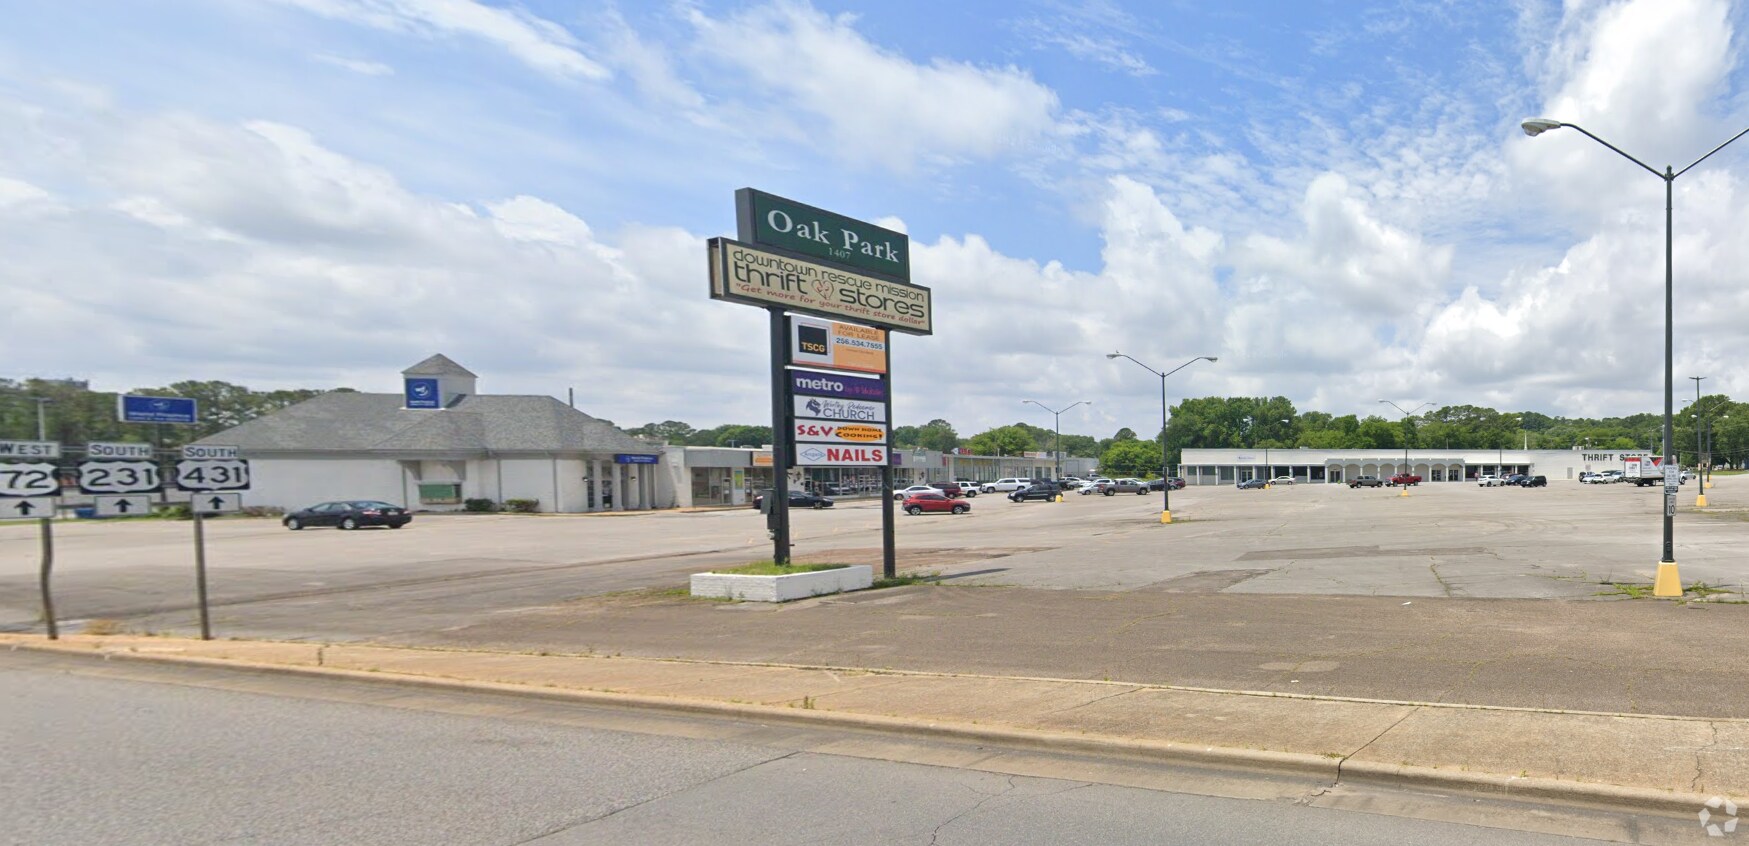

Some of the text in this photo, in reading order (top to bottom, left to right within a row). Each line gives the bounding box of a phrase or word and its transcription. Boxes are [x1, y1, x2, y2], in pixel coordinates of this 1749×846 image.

[767, 209, 900, 263] Oak Park
[828, 247, 852, 260] 1407
[733, 249, 925, 303] downtown rescue mission
[734, 261, 925, 319] thrift stores
[766, 290, 797, 301] more
[800, 296, 817, 304] for
[818, 301, 843, 309] your
[845, 305, 871, 316] thrift
[873, 311, 897, 321] store
[839, 325, 880, 335] AVAILABLE
[801, 341, 826, 353] TSCG
[795, 378, 843, 393] metro
[823, 408, 875, 420] CHURCH
[797, 425, 833, 437] S&V
[0, 443, 52, 455] WEST
[91, 444, 149, 456] SOUTH
[185, 447, 237, 457] SOUTH
[827, 448, 883, 462] NAILS
[1582, 453, 1614, 461] THRIFT
[0, 470, 50, 488] 72
[87, 468, 153, 486] 231
[184, 466, 241, 483] 431
[1668, 505, 1675, 514] 10
